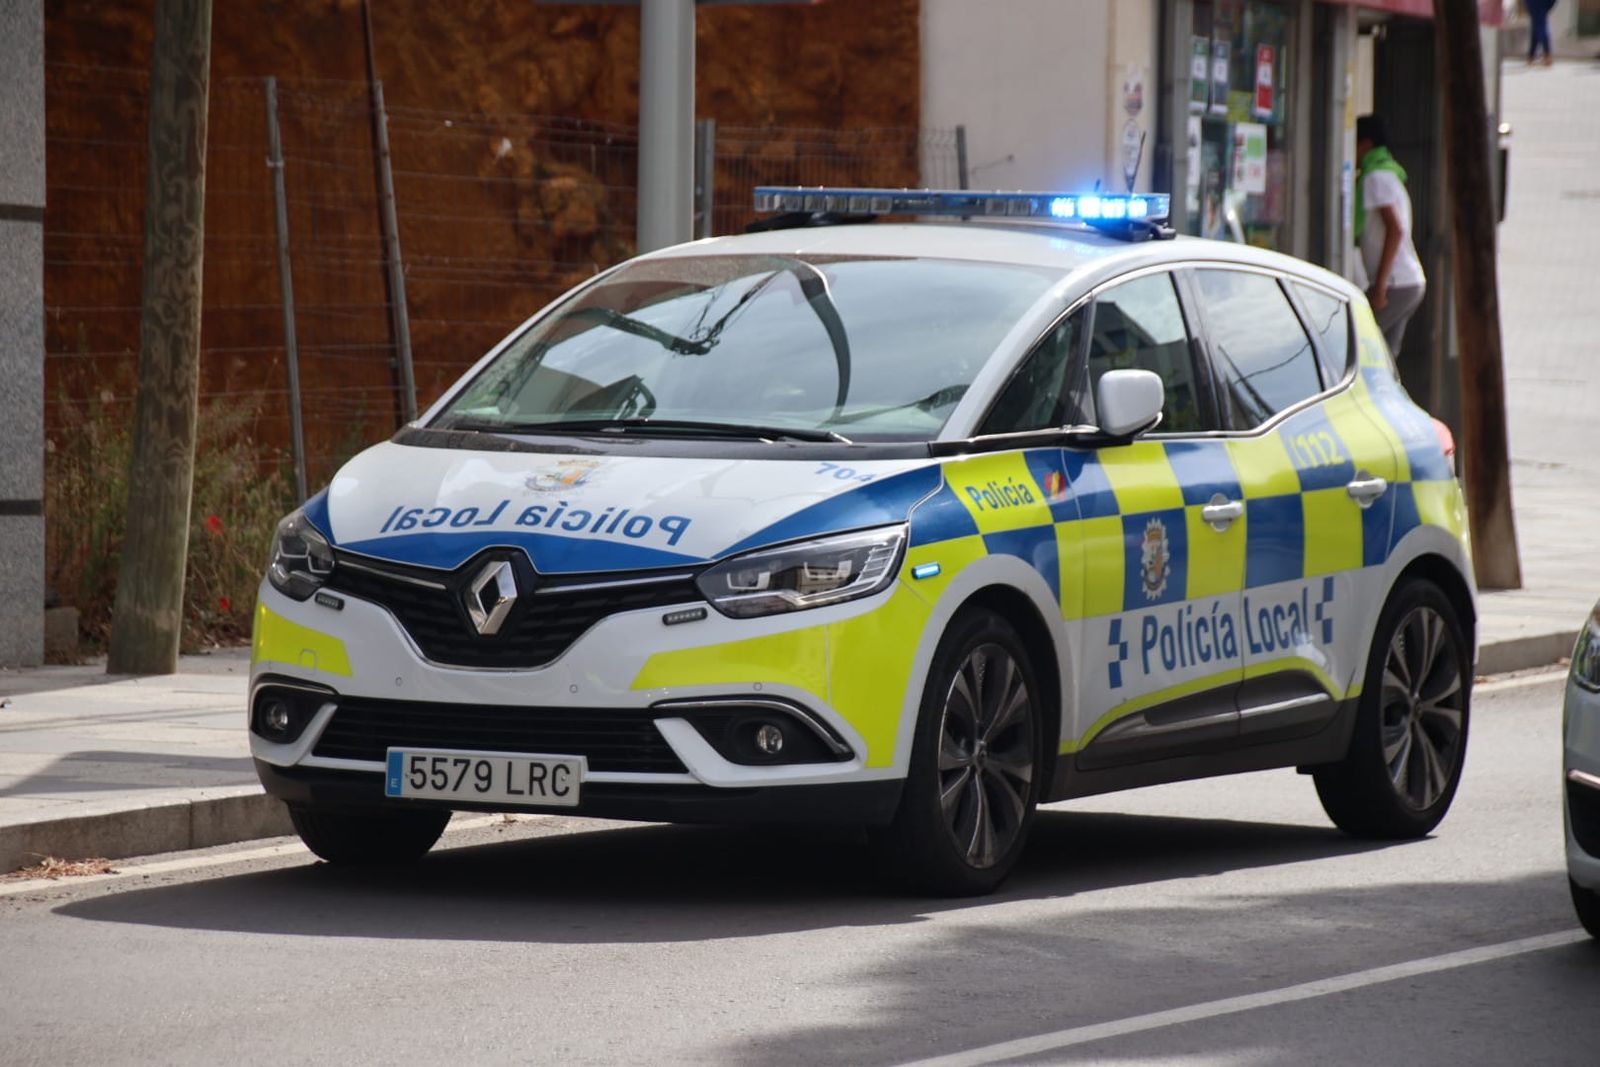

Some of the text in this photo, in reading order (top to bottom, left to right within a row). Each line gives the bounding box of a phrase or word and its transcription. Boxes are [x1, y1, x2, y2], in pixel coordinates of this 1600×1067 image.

[965, 476, 1034, 511] Policía
[1141, 587, 1308, 675] Policía Local
[409, 755, 571, 798] 5579 LRC
